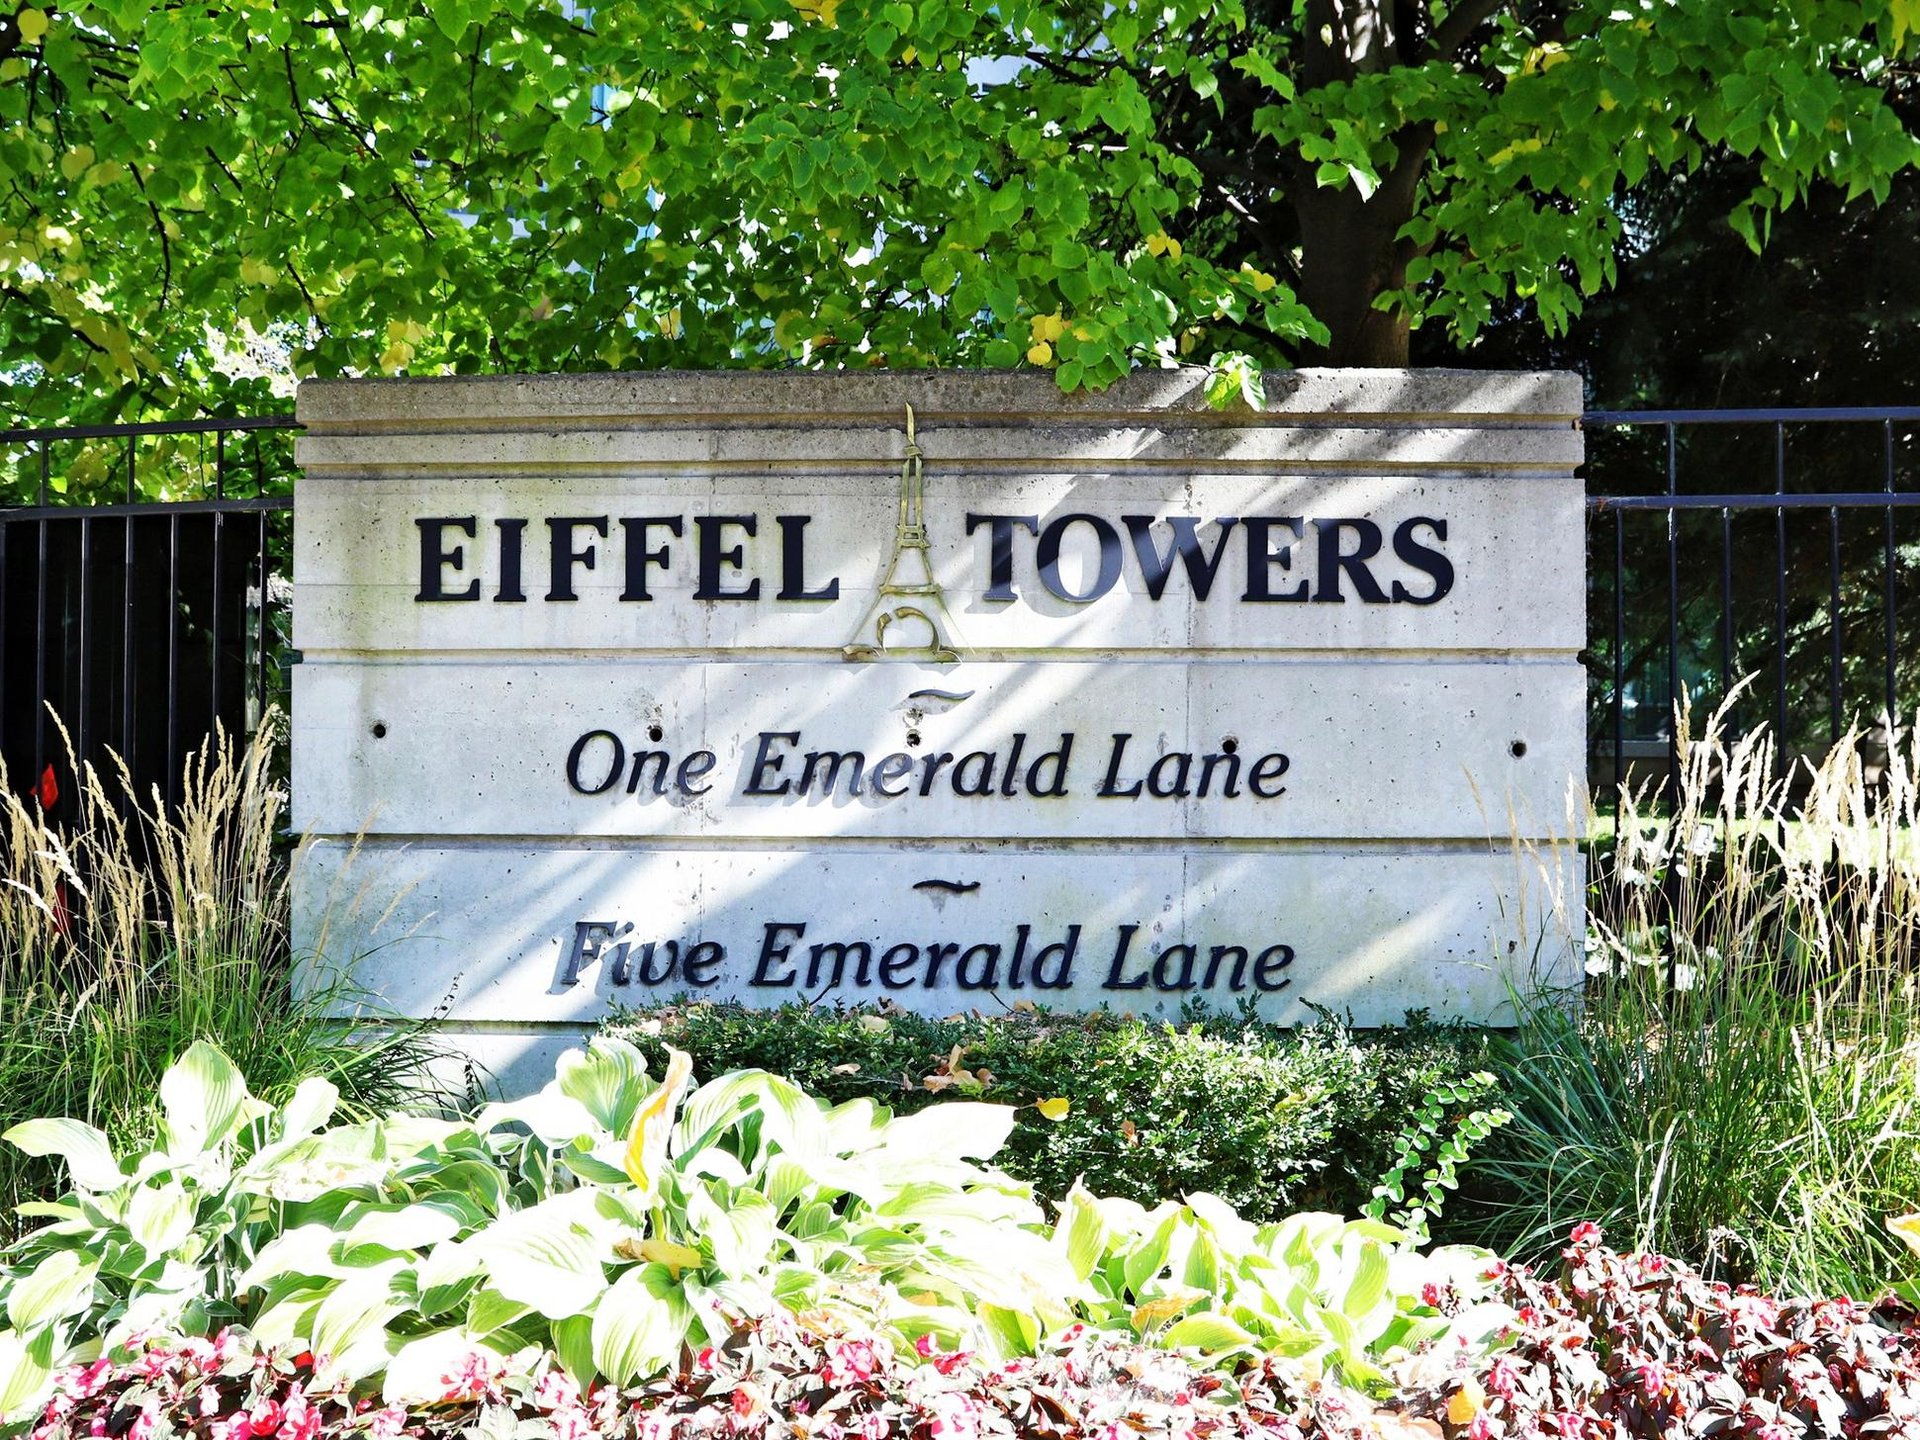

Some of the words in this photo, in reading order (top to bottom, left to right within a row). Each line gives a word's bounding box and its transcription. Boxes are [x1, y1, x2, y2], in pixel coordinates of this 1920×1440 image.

[414, 513, 840, 603] EIFFEL
[965, 512, 1455, 605] TOWERS
[566, 730, 717, 795] One
[743, 731, 1077, 798] Emerald
[1096, 734, 1291, 799] Lane
[562, 921, 724, 986] Five
[750, 922, 1082, 989] Emerald
[1101, 924, 1295, 990] Lane
